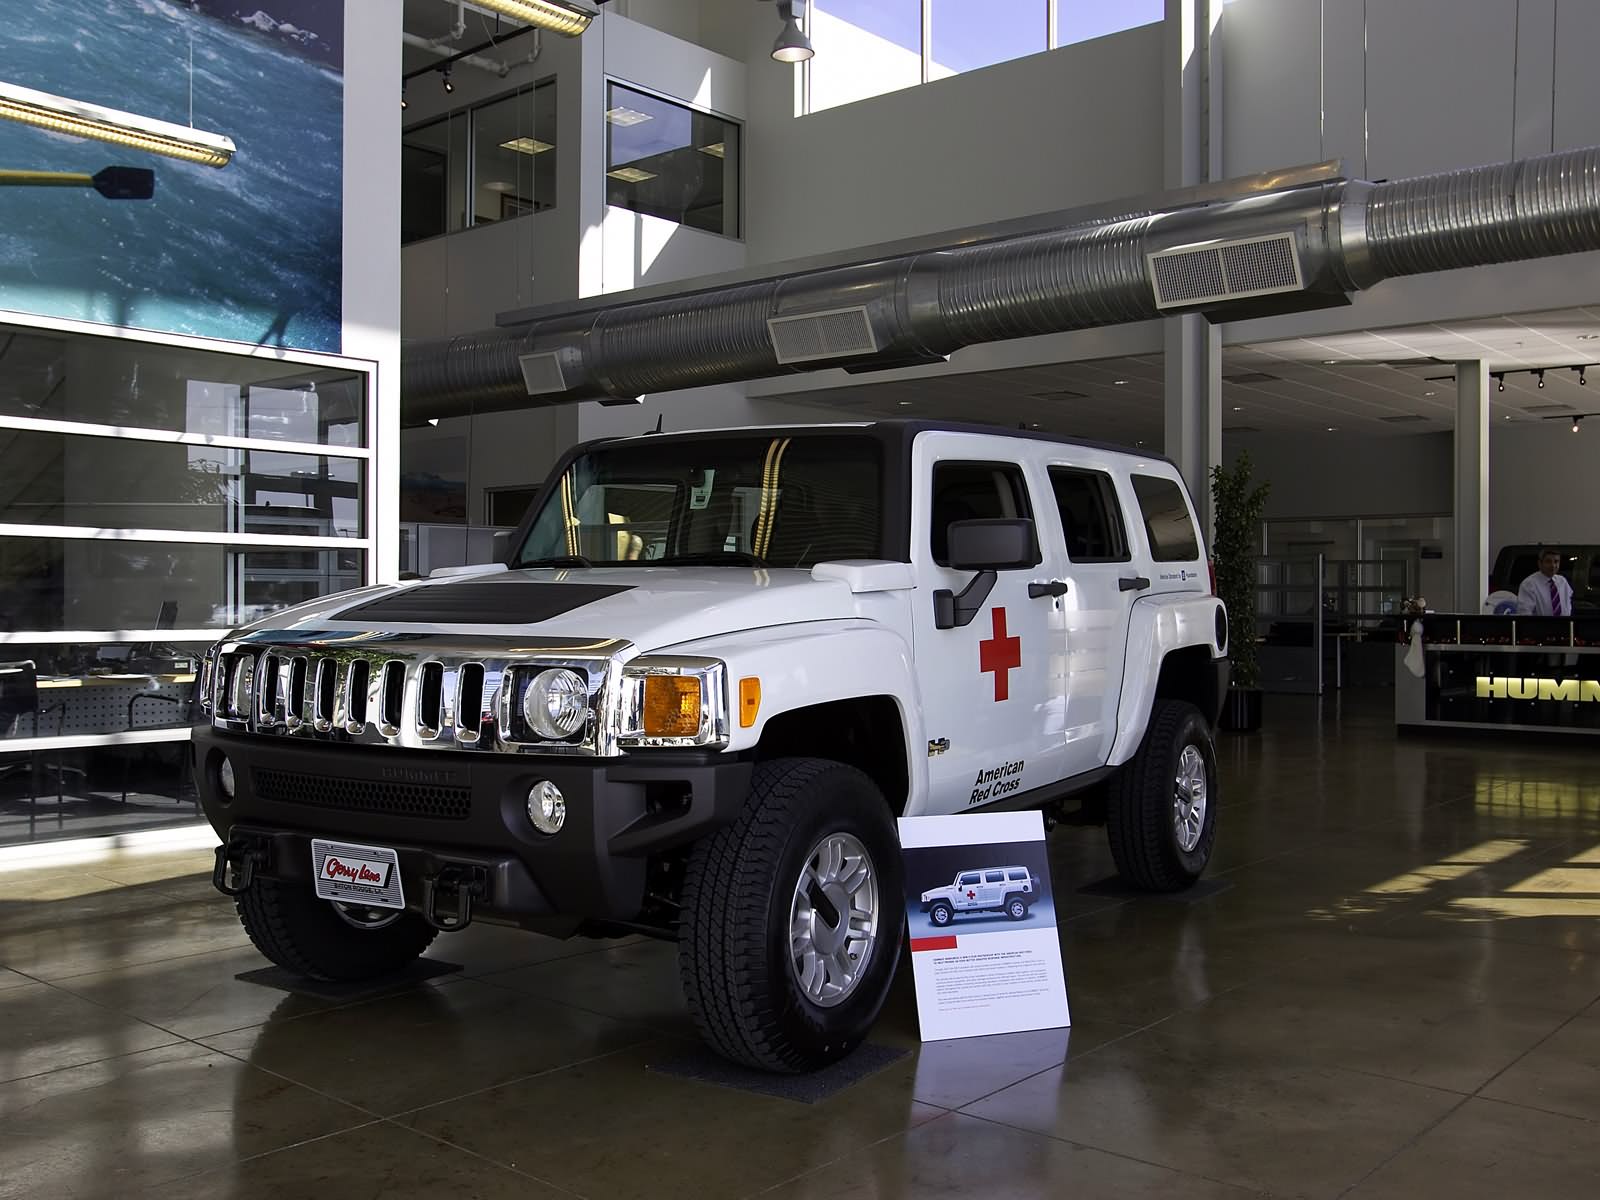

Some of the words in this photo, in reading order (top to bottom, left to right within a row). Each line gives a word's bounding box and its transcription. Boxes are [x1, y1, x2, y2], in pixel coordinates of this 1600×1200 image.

[975, 760, 1025, 786] American
[969, 784, 992, 805] Red
[992, 778, 1021, 797] Cross
[326, 858, 359, 883] Gerry
[358, 864, 381, 883] Lane
